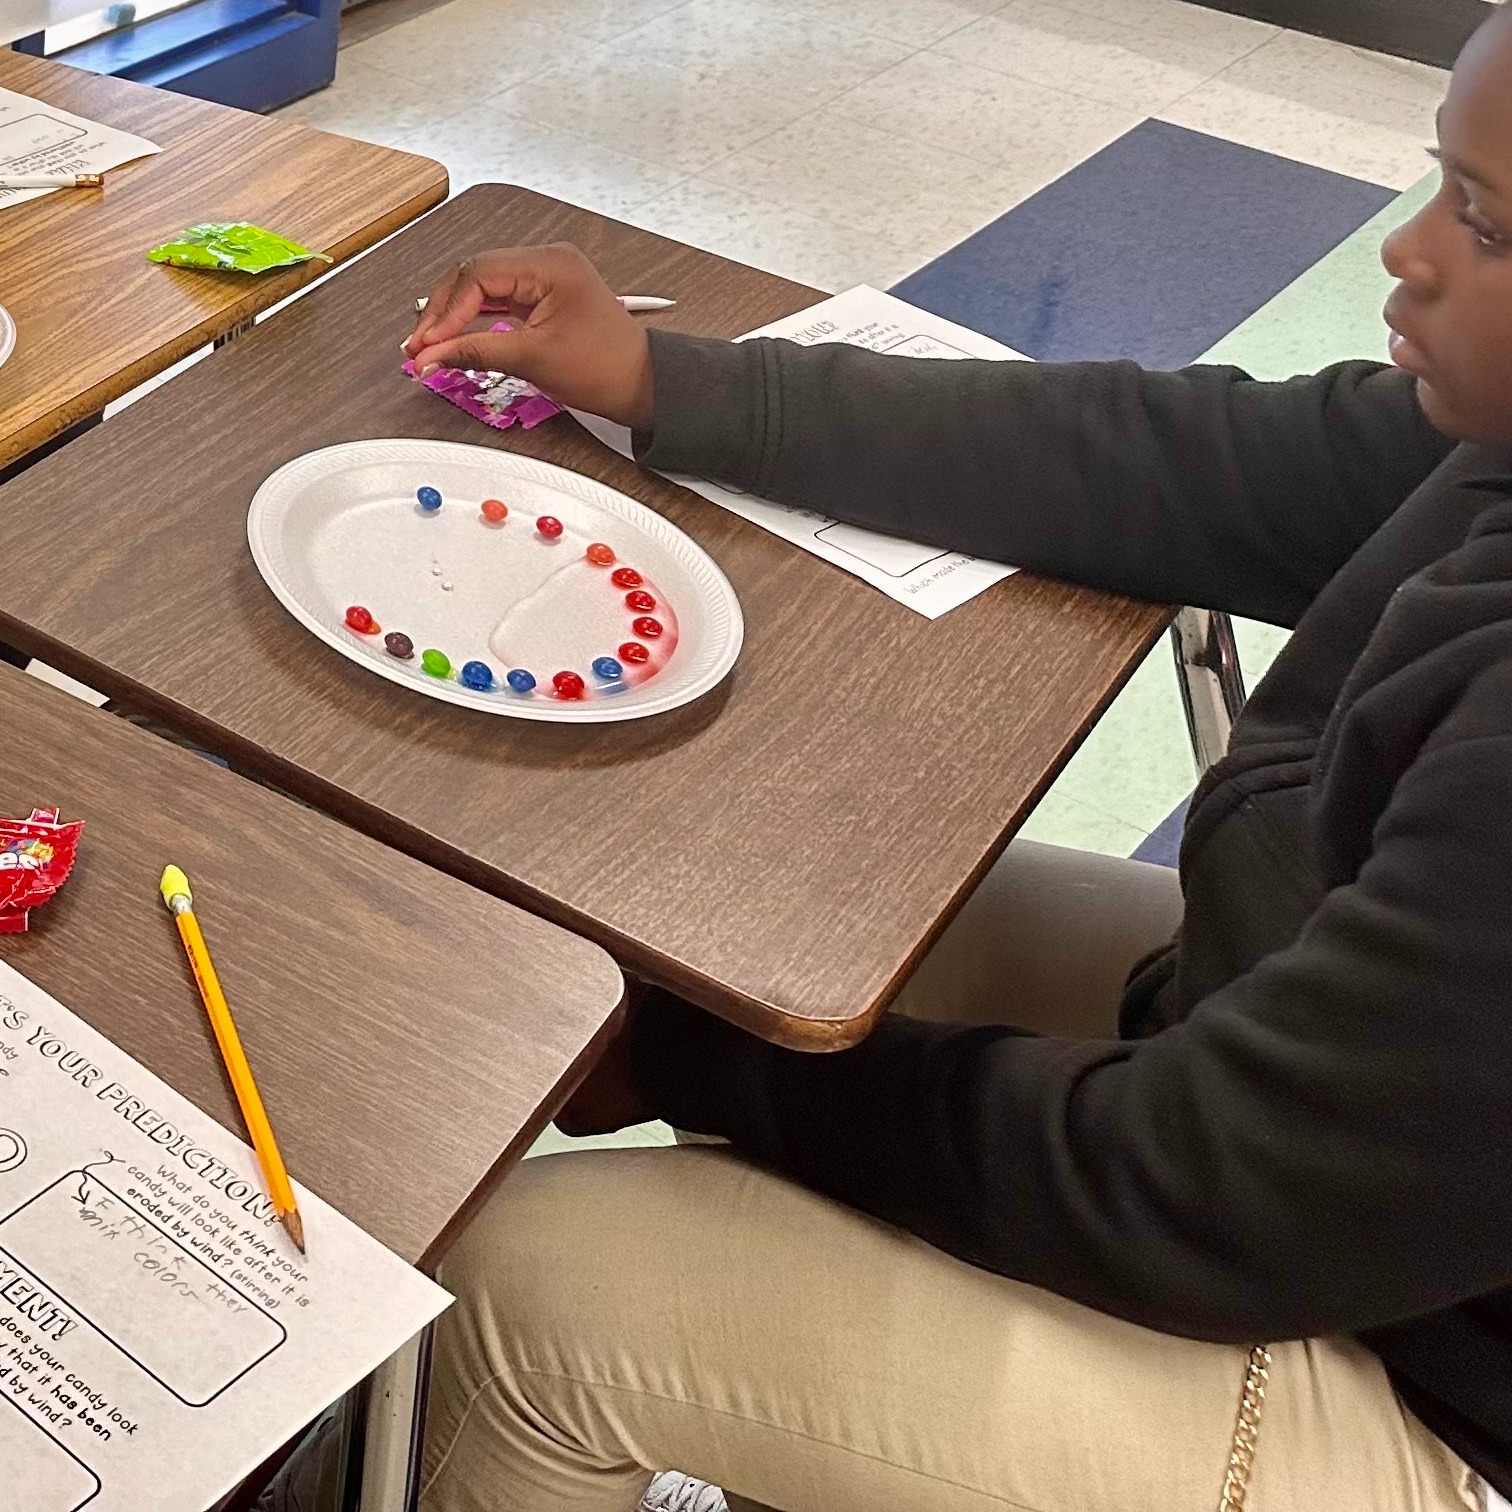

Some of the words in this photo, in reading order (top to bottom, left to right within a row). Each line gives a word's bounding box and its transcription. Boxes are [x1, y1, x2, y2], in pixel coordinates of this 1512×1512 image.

[27, 1026, 103, 1088] YOUR
[127, 1188, 174, 1223] eroded
[171, 1221, 190, 1238] by
[191, 1237, 233, 1268] wind?
[230, 1270, 280, 1309] (stirring)
